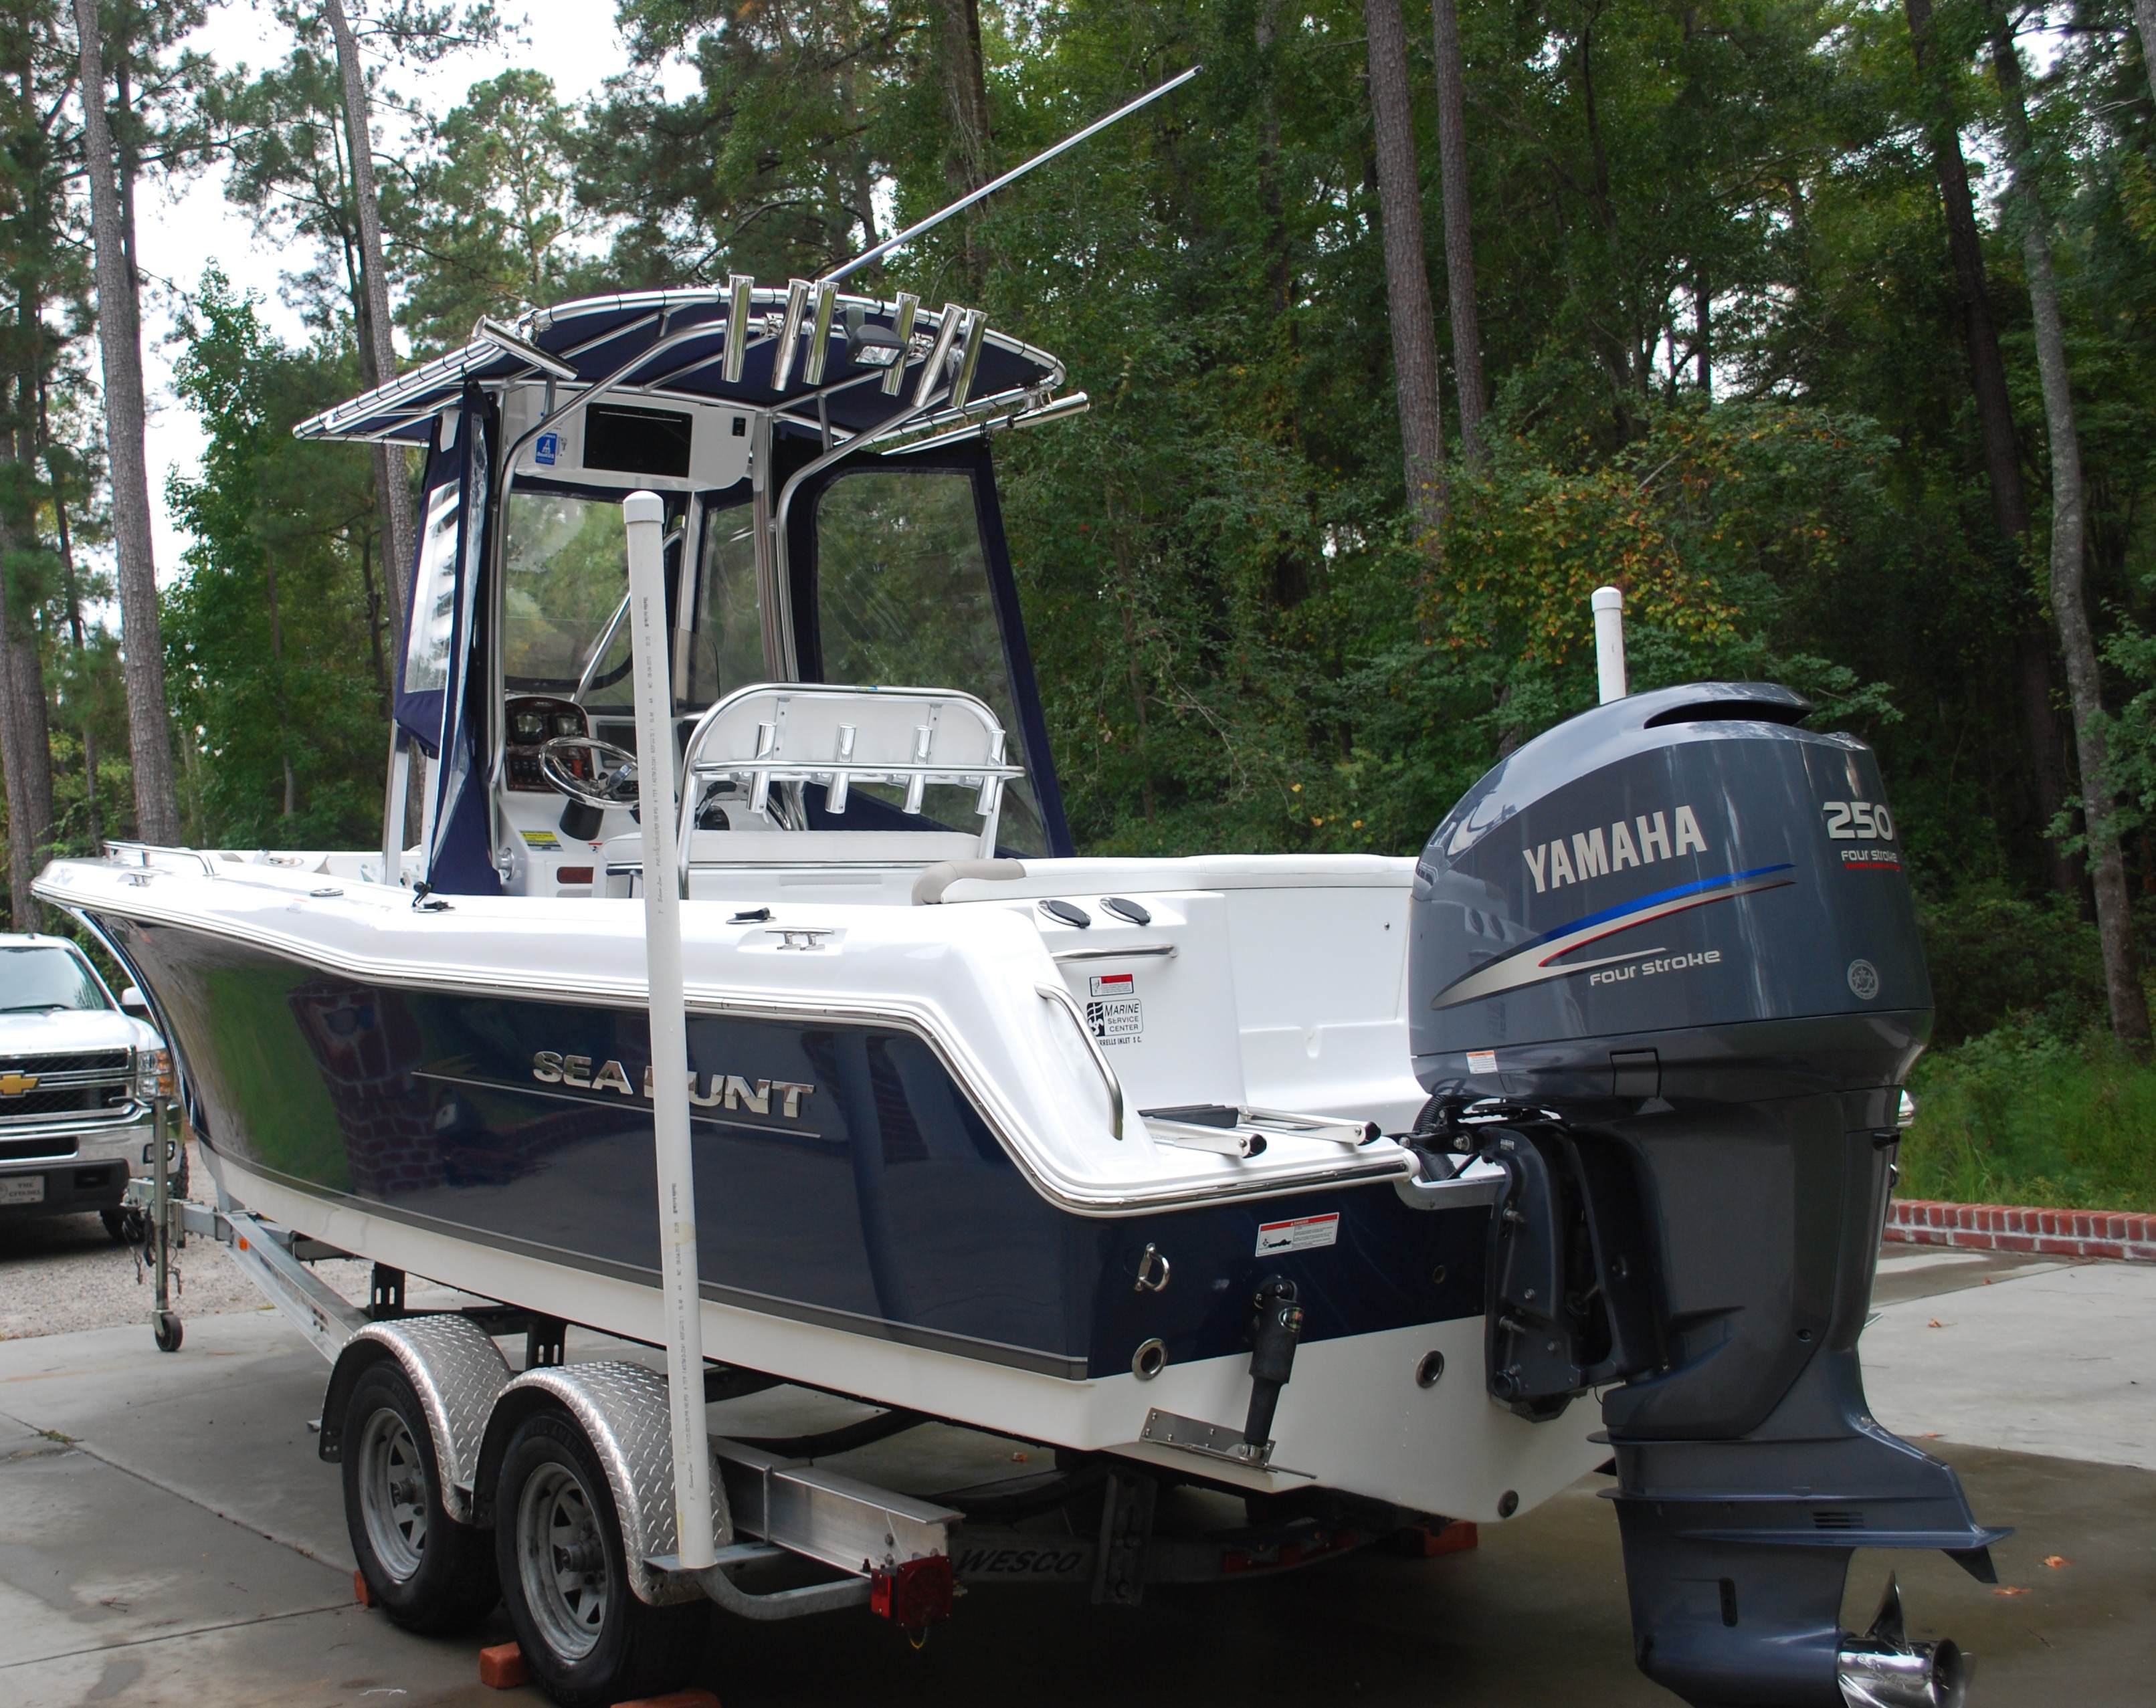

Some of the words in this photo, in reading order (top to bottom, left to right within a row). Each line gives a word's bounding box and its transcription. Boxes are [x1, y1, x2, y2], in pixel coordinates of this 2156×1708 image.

[1822, 802, 1893, 841] 250
[1523, 805, 1707, 893] YAMAHA
[1104, 1003, 1140, 1017] MARINE
[1107, 1016, 1139, 1025] SERVICE
[1109, 1024, 1139, 1033] CENTER
[1099, 1038, 1116, 1046] RRELLS
[533, 1051, 633, 1095] SEA
[956, 1549, 1082, 1573] WESCO
